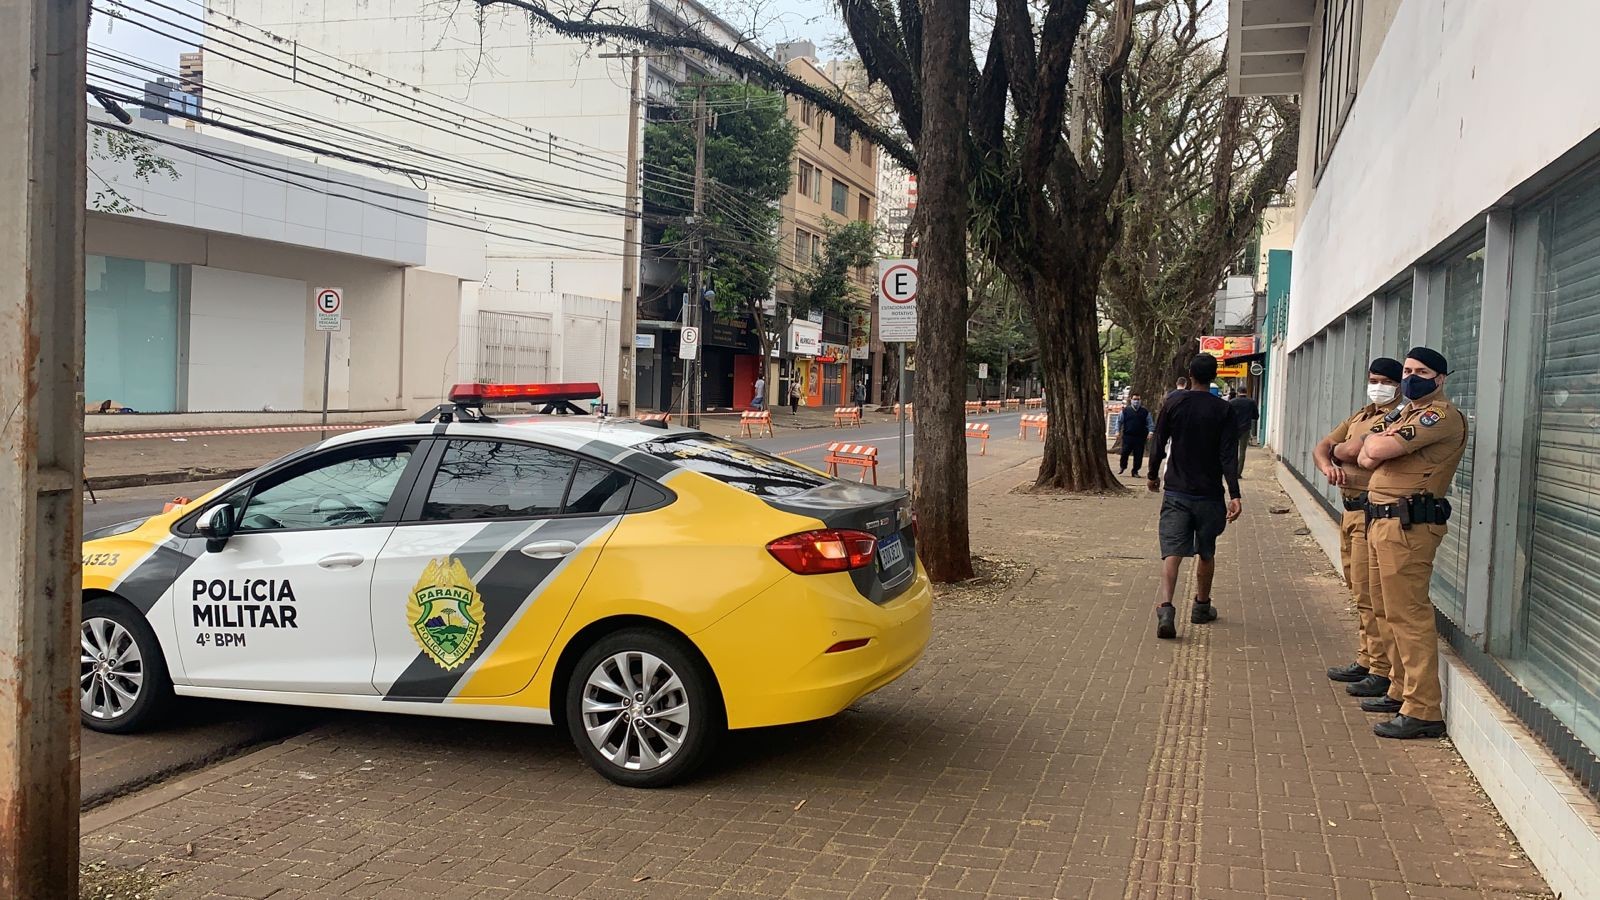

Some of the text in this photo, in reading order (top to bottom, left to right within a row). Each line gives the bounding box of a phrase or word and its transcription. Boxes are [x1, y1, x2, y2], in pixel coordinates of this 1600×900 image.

[895, 273, 907, 295] E
[325, 294, 334, 308] E
[686, 331, 692, 341] E
[419, 589, 470, 602] PARANÁ
[193, 604, 298, 628] MILITAR
[214, 633, 246, 647] BPM
[453, 626, 475, 658] MILITAR
